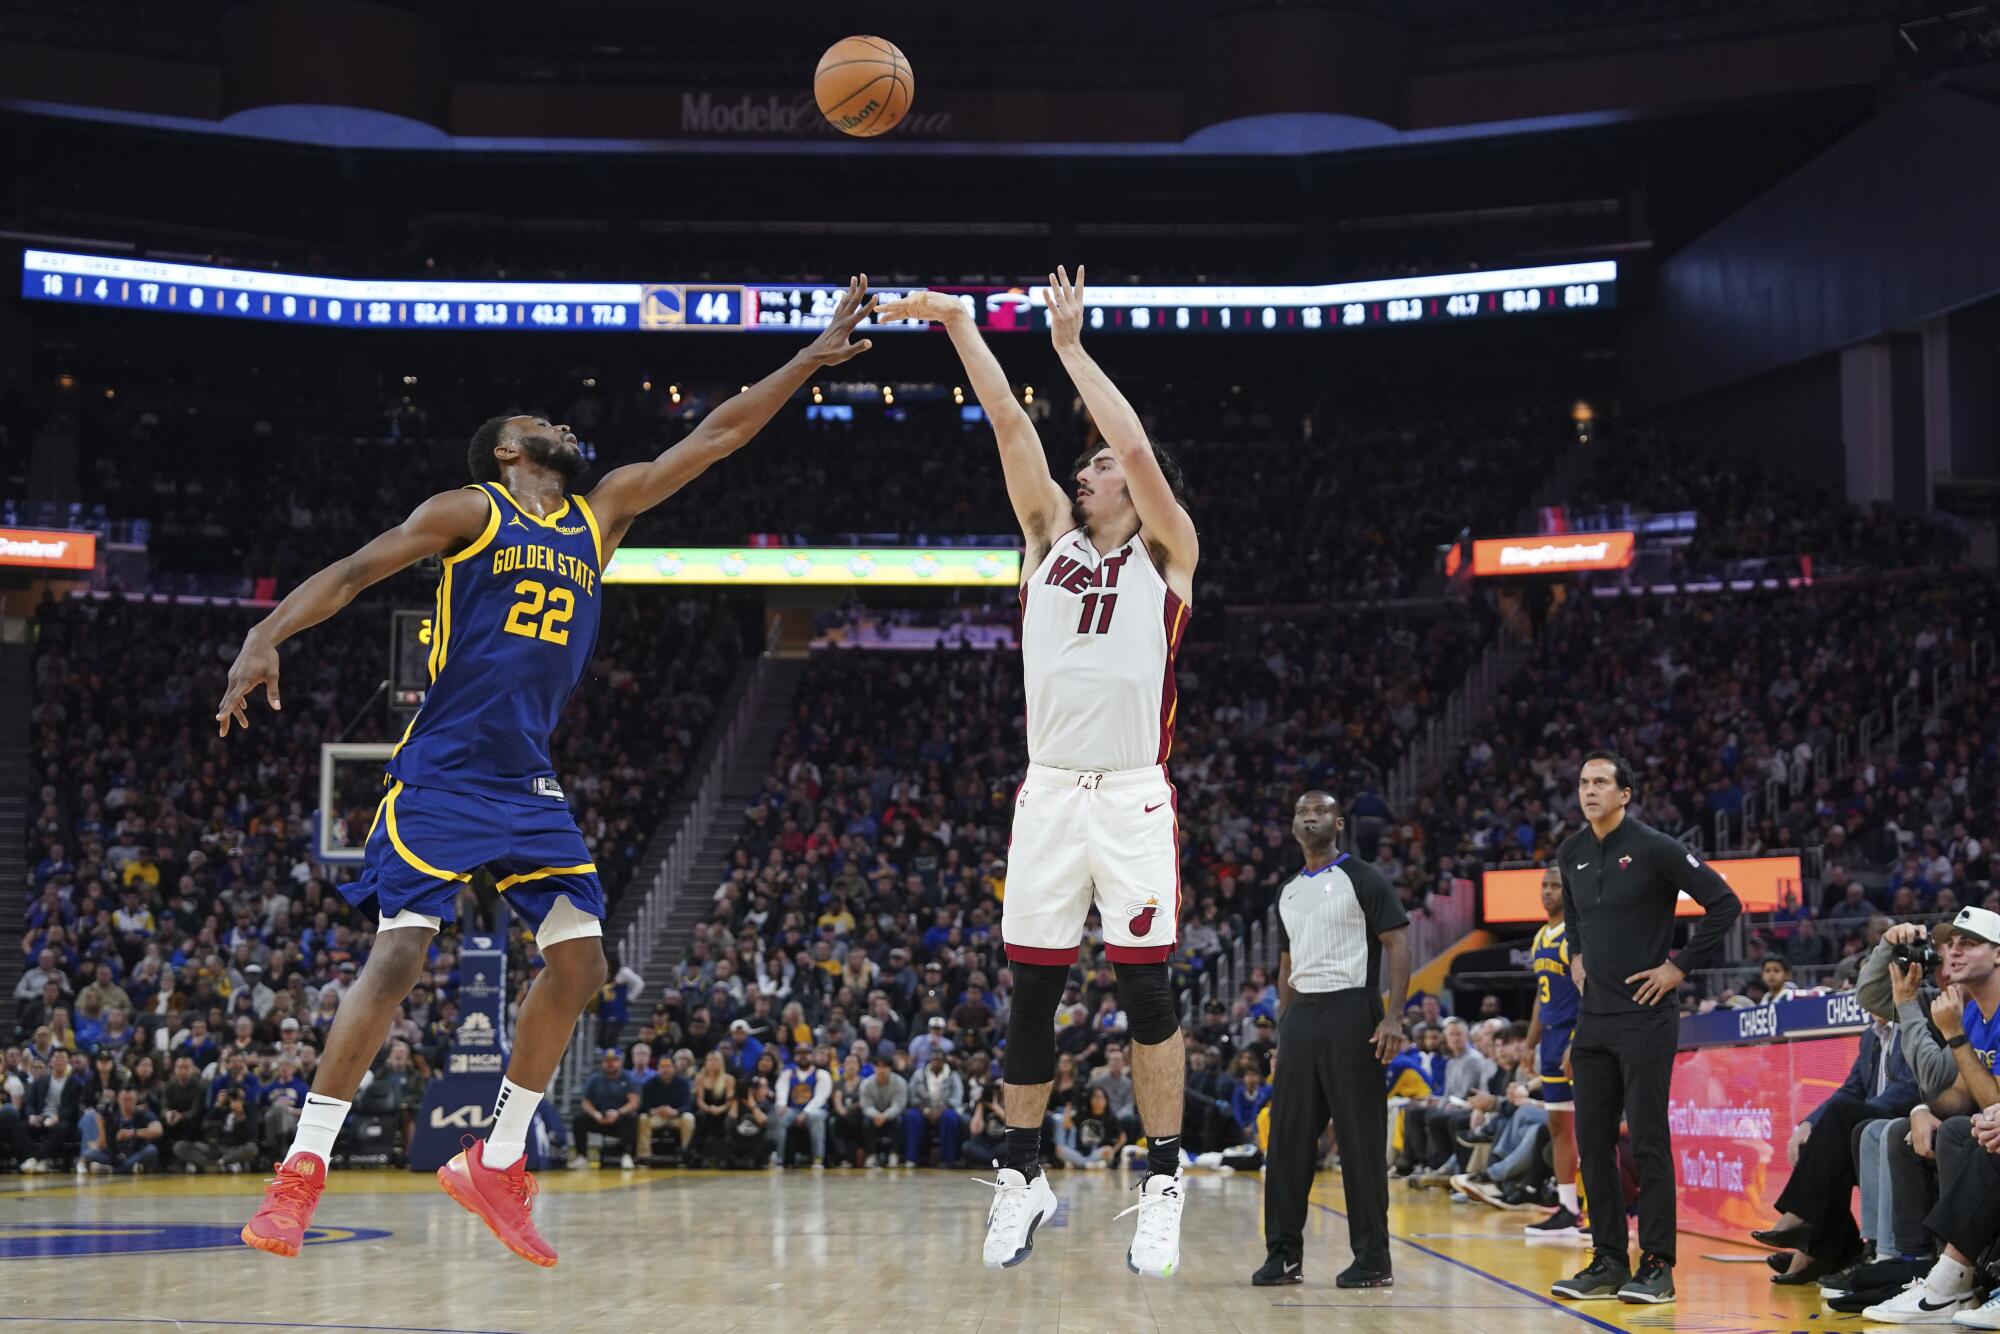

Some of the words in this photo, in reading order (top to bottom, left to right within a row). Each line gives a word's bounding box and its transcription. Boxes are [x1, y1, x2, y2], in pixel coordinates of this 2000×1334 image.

[681, 92, 797, 132] Modelo
[94, 278, 109, 300] 4
[235, 291, 250, 312] 4
[695, 292, 731, 324] 44
[1219, 307, 1231, 328] 1
[492, 544, 555, 576] GOLDEN
[557, 553, 597, 598] STATE
[1044, 544, 1133, 595] HEAT
[503, 579, 576, 647] 22
[1077, 592, 1119, 635] 11
[1537, 975, 1551, 1004] 3
[1739, 1008, 1769, 1038] CHASE
[1827, 997, 1861, 1025] CHASE
[1716, 1151, 1744, 1193] Trust
